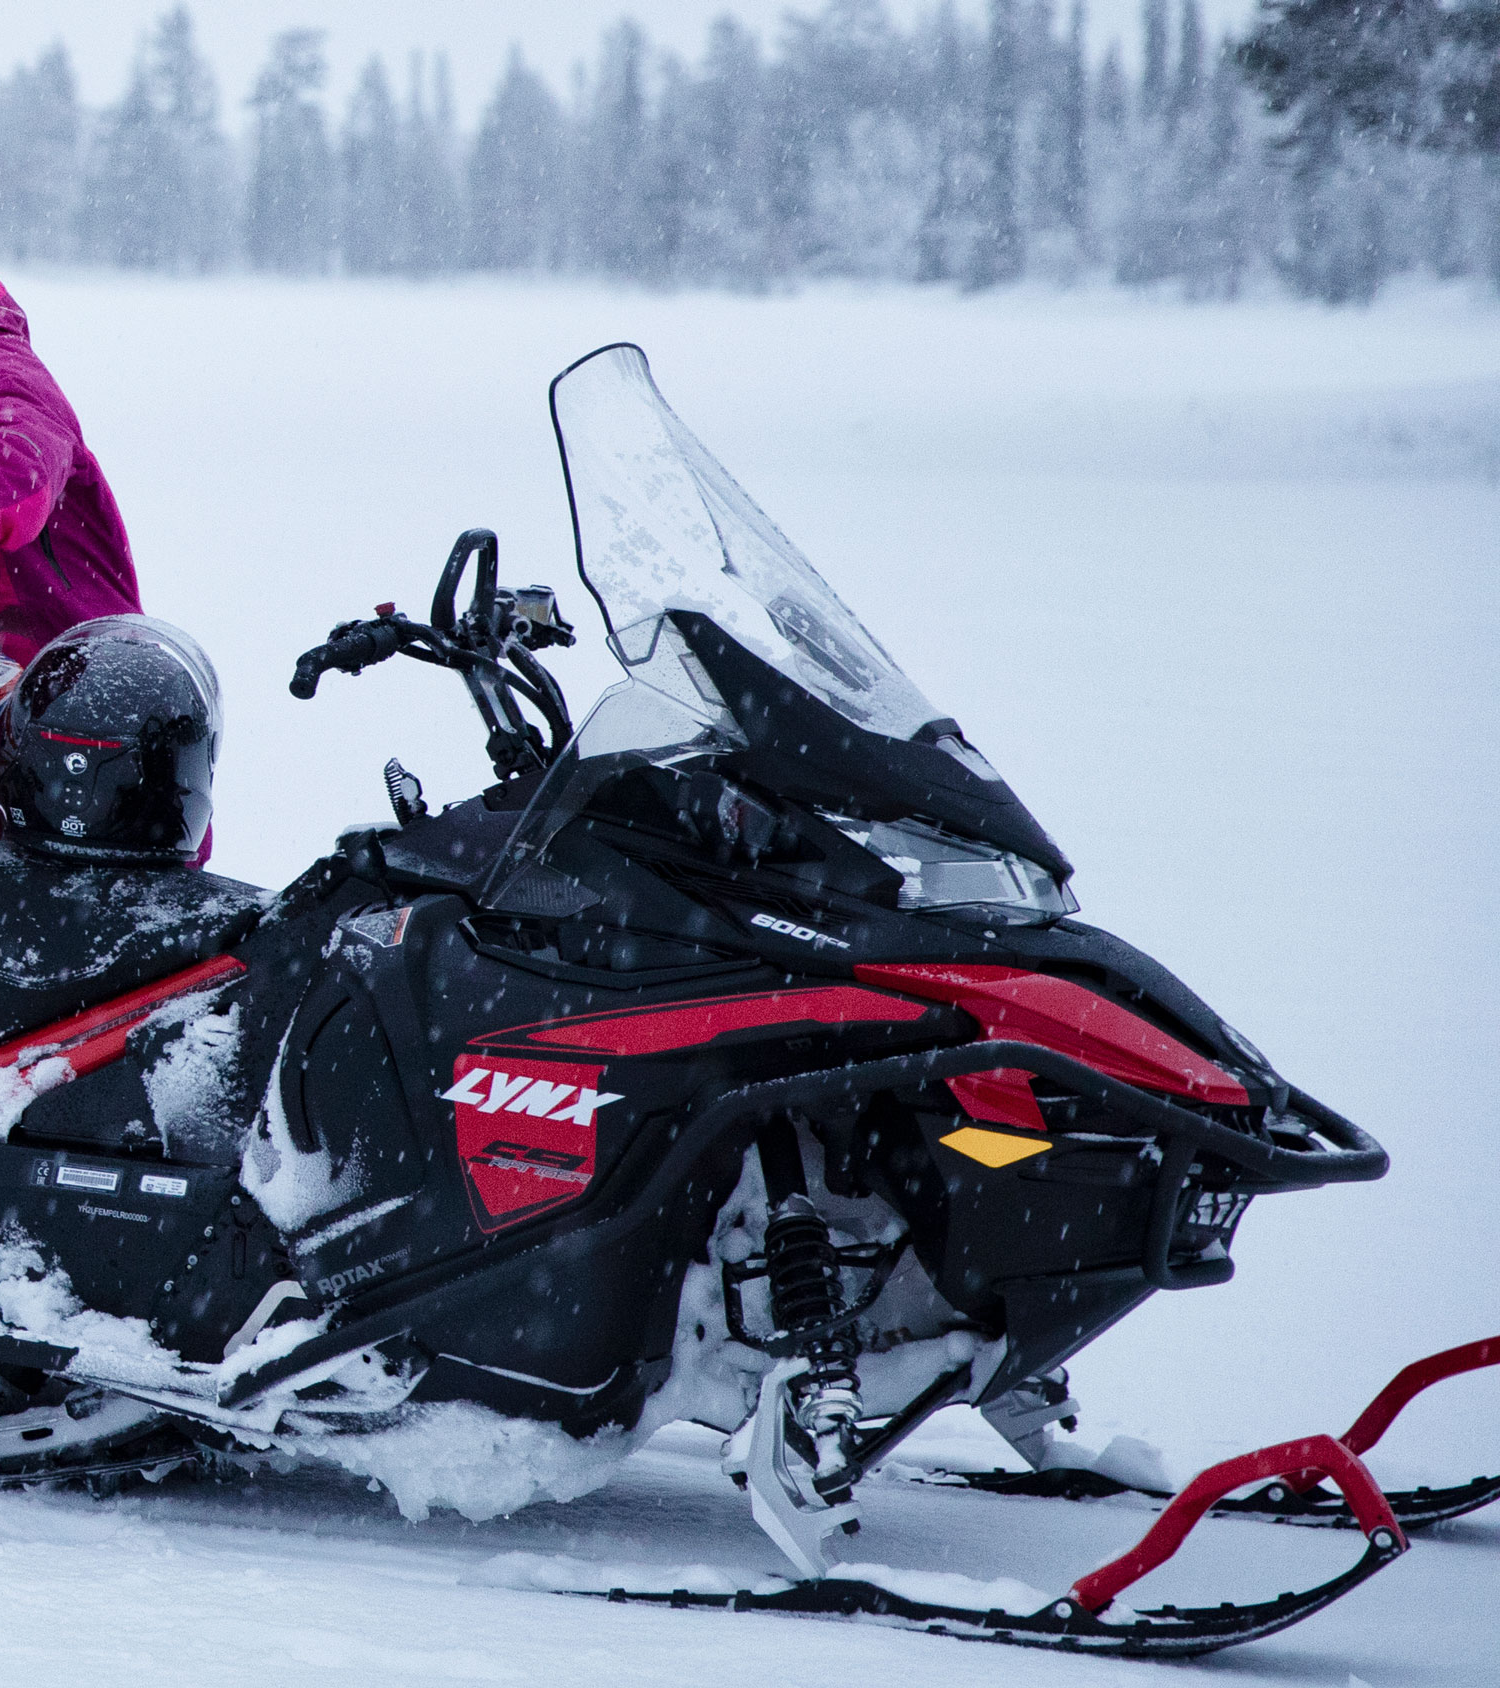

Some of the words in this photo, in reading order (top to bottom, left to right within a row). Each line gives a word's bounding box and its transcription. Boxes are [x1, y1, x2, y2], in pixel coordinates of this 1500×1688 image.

[61, 820, 86, 832] DOT
[750, 913, 817, 941] 600
[440, 1067, 626, 1127] LYNX
[316, 1259, 385, 1296] ROTAX
